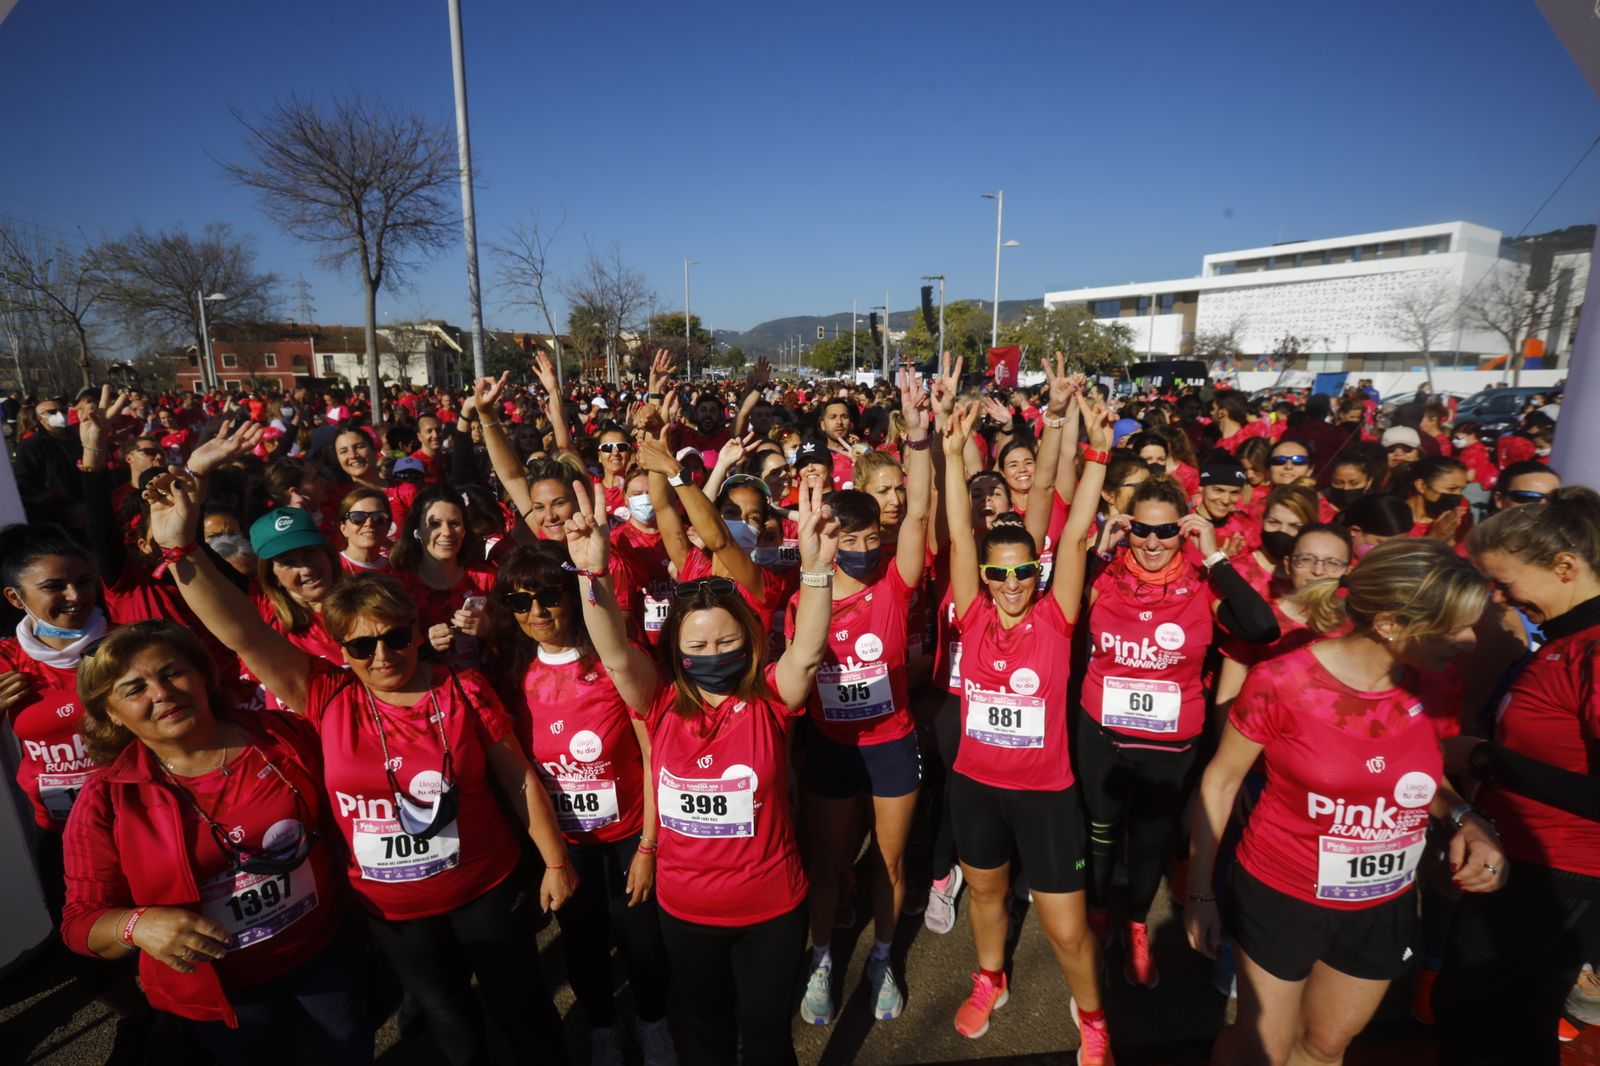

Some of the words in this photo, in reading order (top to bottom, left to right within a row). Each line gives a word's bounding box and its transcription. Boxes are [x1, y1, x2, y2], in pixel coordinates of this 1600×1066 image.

[1101, 631, 1158, 660] Pink
[1115, 655, 1167, 670] RUNNING
[837, 682, 871, 703] 375
[1129, 692, 1154, 712] 60
[988, 706, 1022, 728] 881
[680, 793, 727, 816] 398
[1307, 791, 1398, 829] Pink
[1328, 823, 1408, 840] RUNNING
[380, 834, 430, 859] 708
[1346, 850, 1406, 878] 1691
[225, 872, 292, 922] 1397
